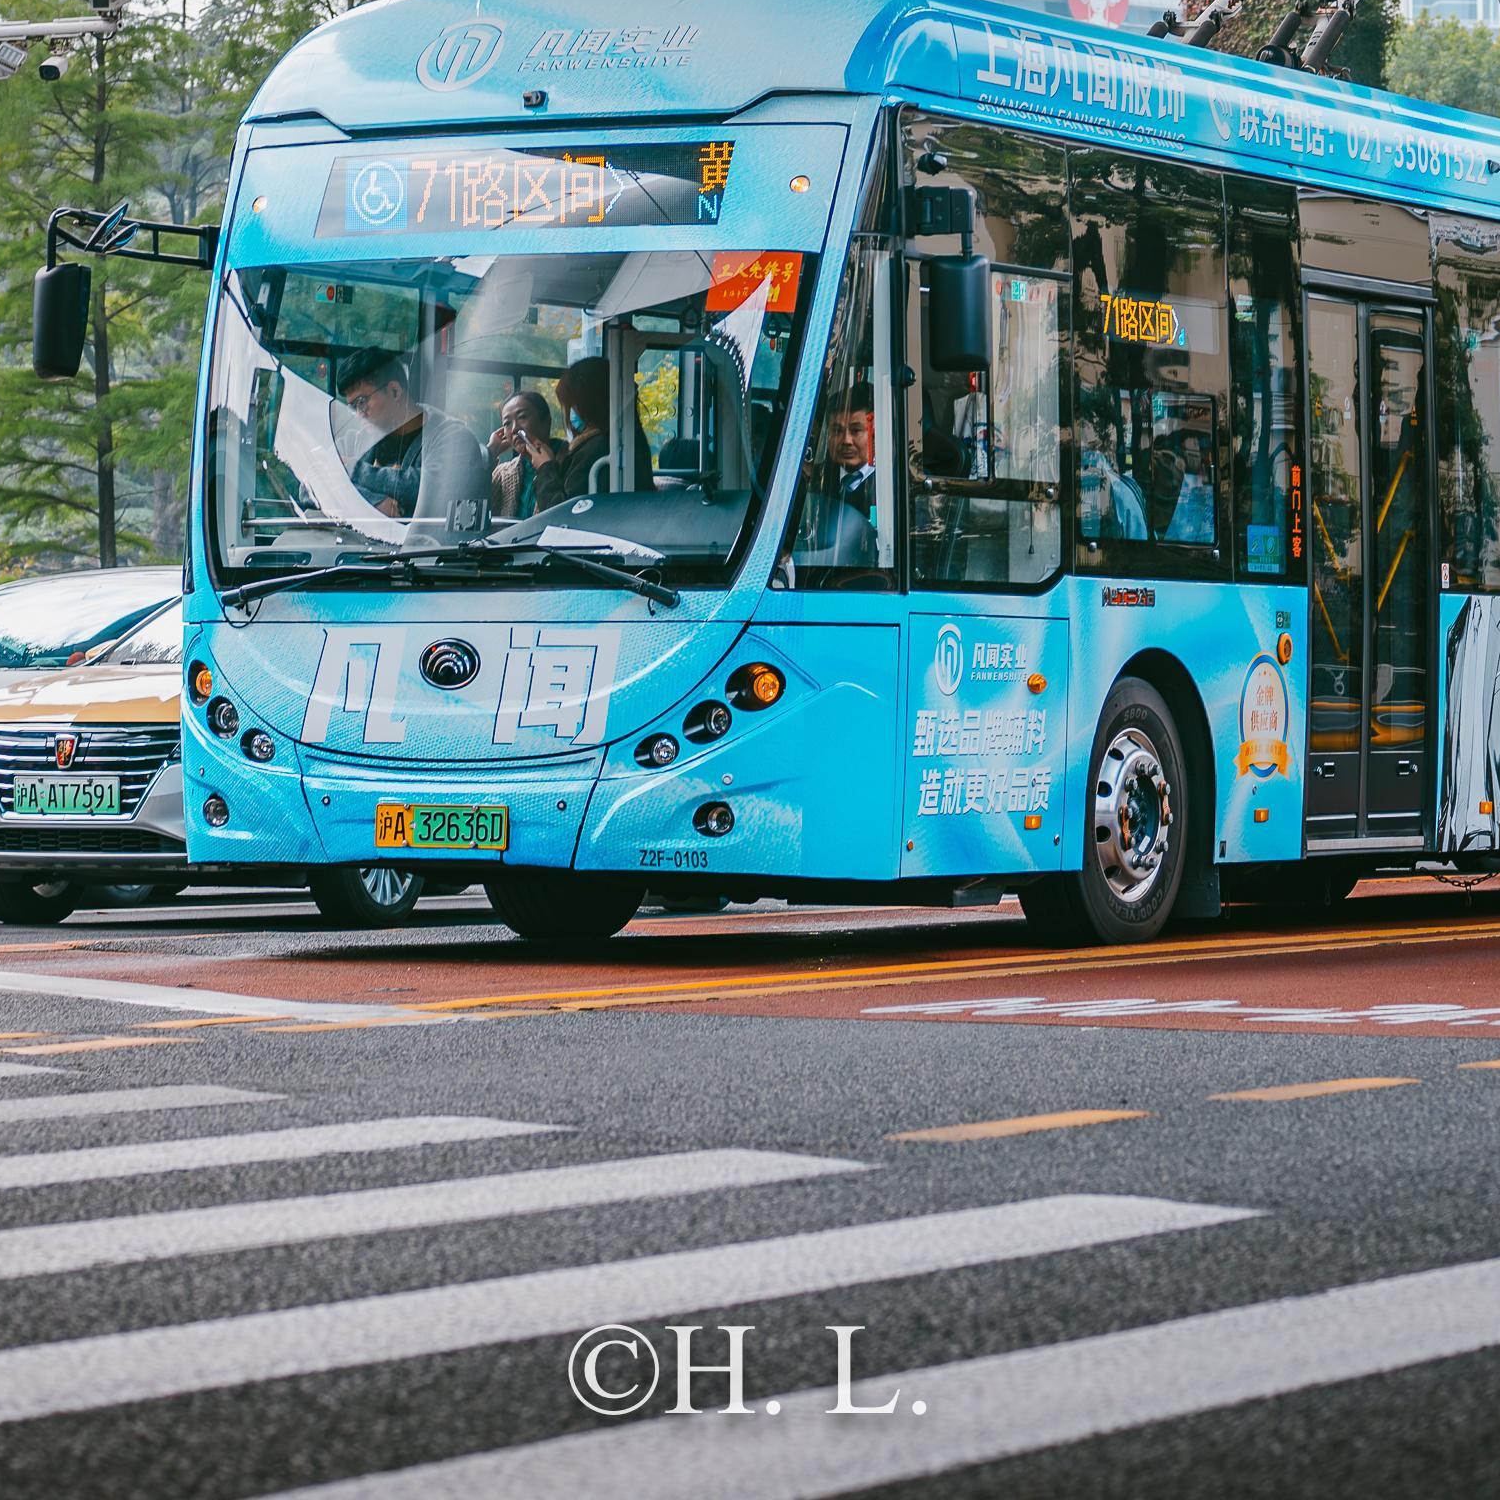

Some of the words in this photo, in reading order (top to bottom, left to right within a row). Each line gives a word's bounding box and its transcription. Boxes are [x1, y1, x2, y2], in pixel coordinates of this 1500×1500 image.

[518, 55, 692, 72] FANWENSHIYE
[526, 24, 702, 58] 凡闻实业
[977, 21, 1186, 124] 上海凡闻服饰
[977, 93, 1054, 125] SHANGHAI
[1055, 108, 1116, 138] FANWEN
[1116, 121, 1186, 151] CLOTHING
[1347, 122, 1488, 185] 021-35081522
[411, 153, 605, 227] 71路区间
[1100, 294, 1174, 345] 71路区间
[1291, 465, 1302, 558] 前门上客
[972, 642, 1028, 670] 凡闻实业
[300, 627, 621, 746] 凡闻
[917, 766, 1052, 817] 造就更好品质
[639, 849, 709, 869] Z2F-0103
